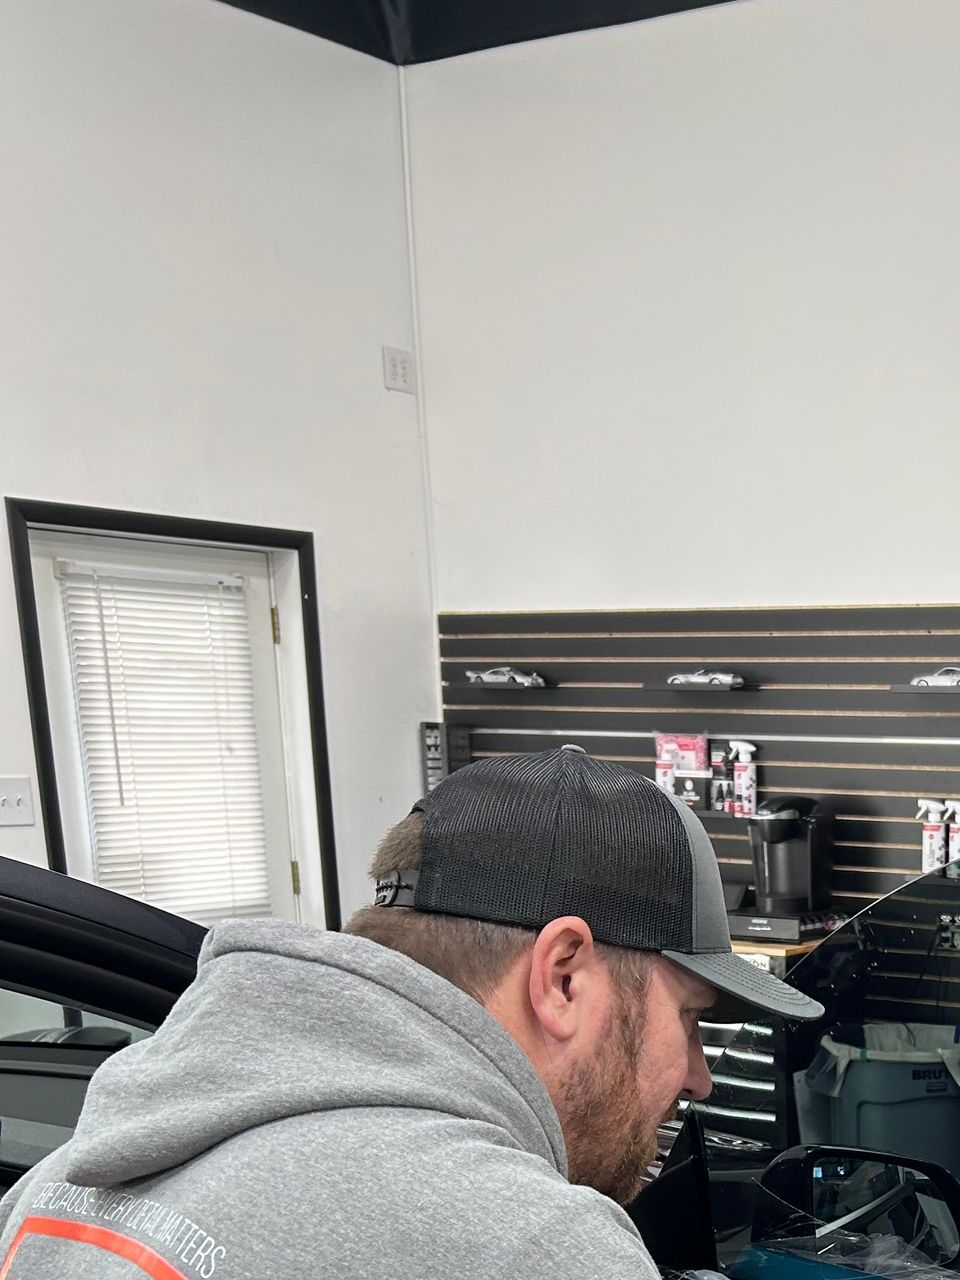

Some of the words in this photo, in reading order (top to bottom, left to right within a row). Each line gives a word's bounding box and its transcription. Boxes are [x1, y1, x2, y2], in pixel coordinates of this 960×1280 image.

[32, 1182, 96, 1215] BECAUSE
[91, 1187, 143, 1223] EVERY
[126, 1198, 168, 1237] DETAIL
[155, 1208, 227, 1279] MATTERS
